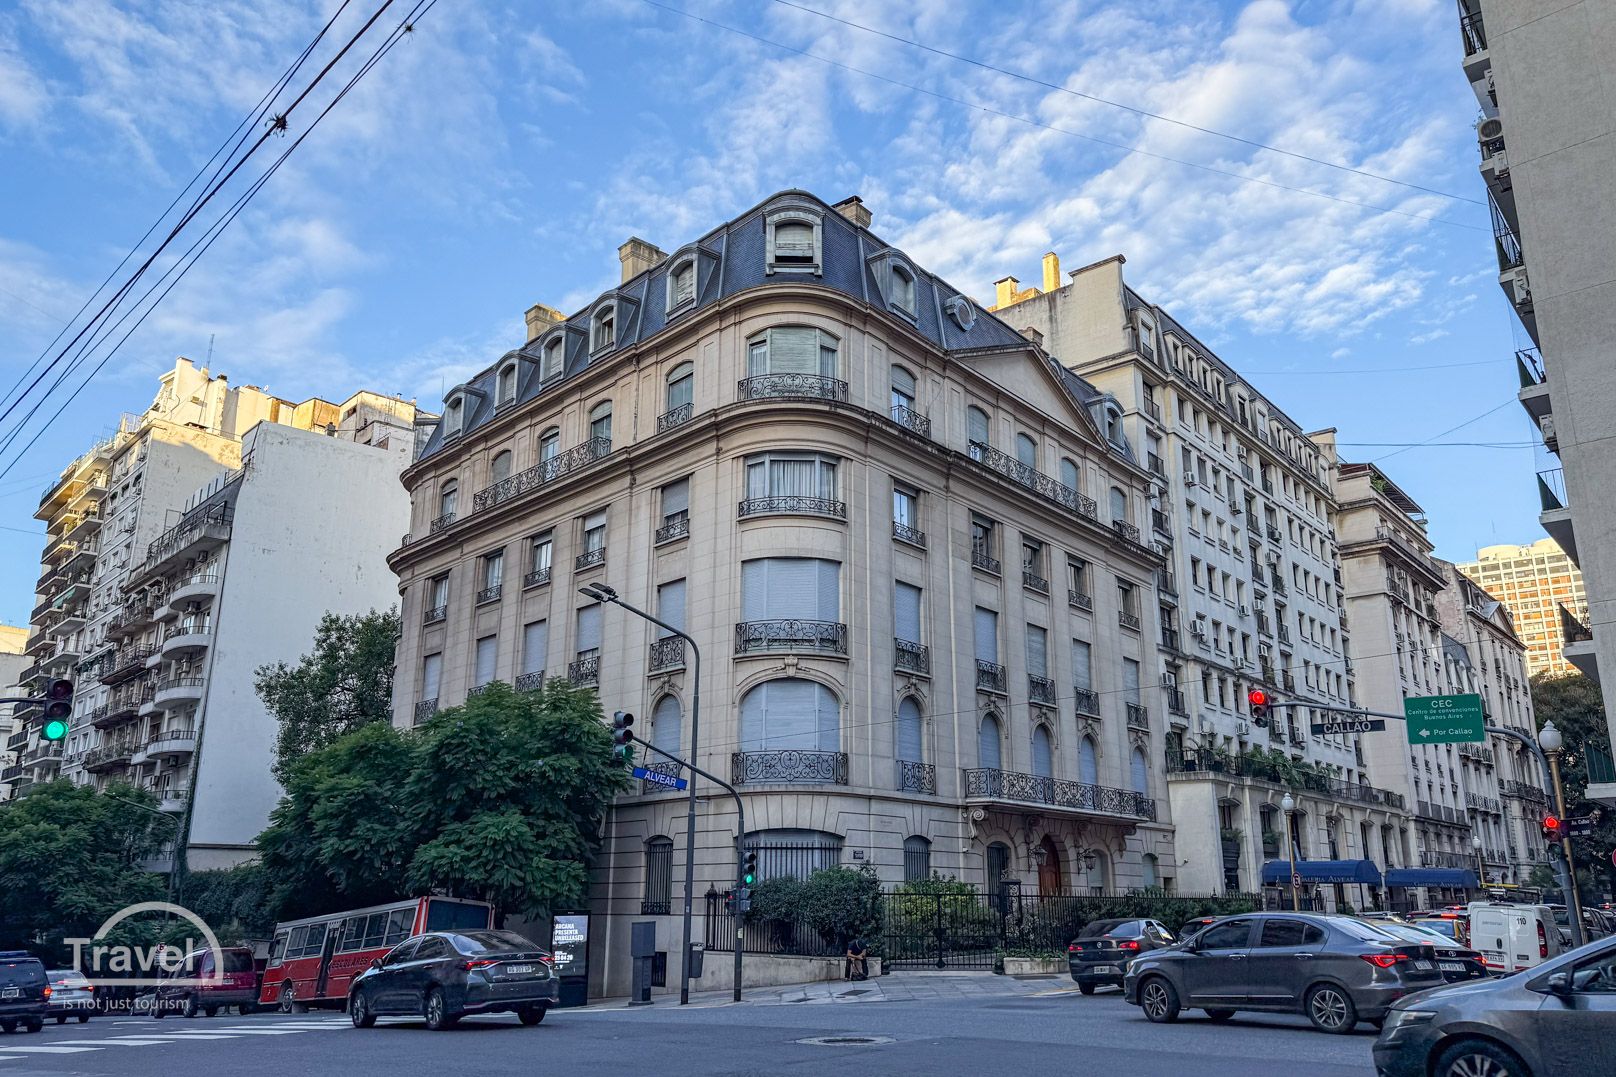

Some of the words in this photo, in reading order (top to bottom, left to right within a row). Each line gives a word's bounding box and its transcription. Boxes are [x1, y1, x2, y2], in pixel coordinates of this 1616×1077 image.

[1431, 699, 1453, 708] CEC
[1323, 721, 1371, 734] CALLAO
[644, 771, 677, 787] ALVEAR
[1517, 917, 1527, 925] 110
